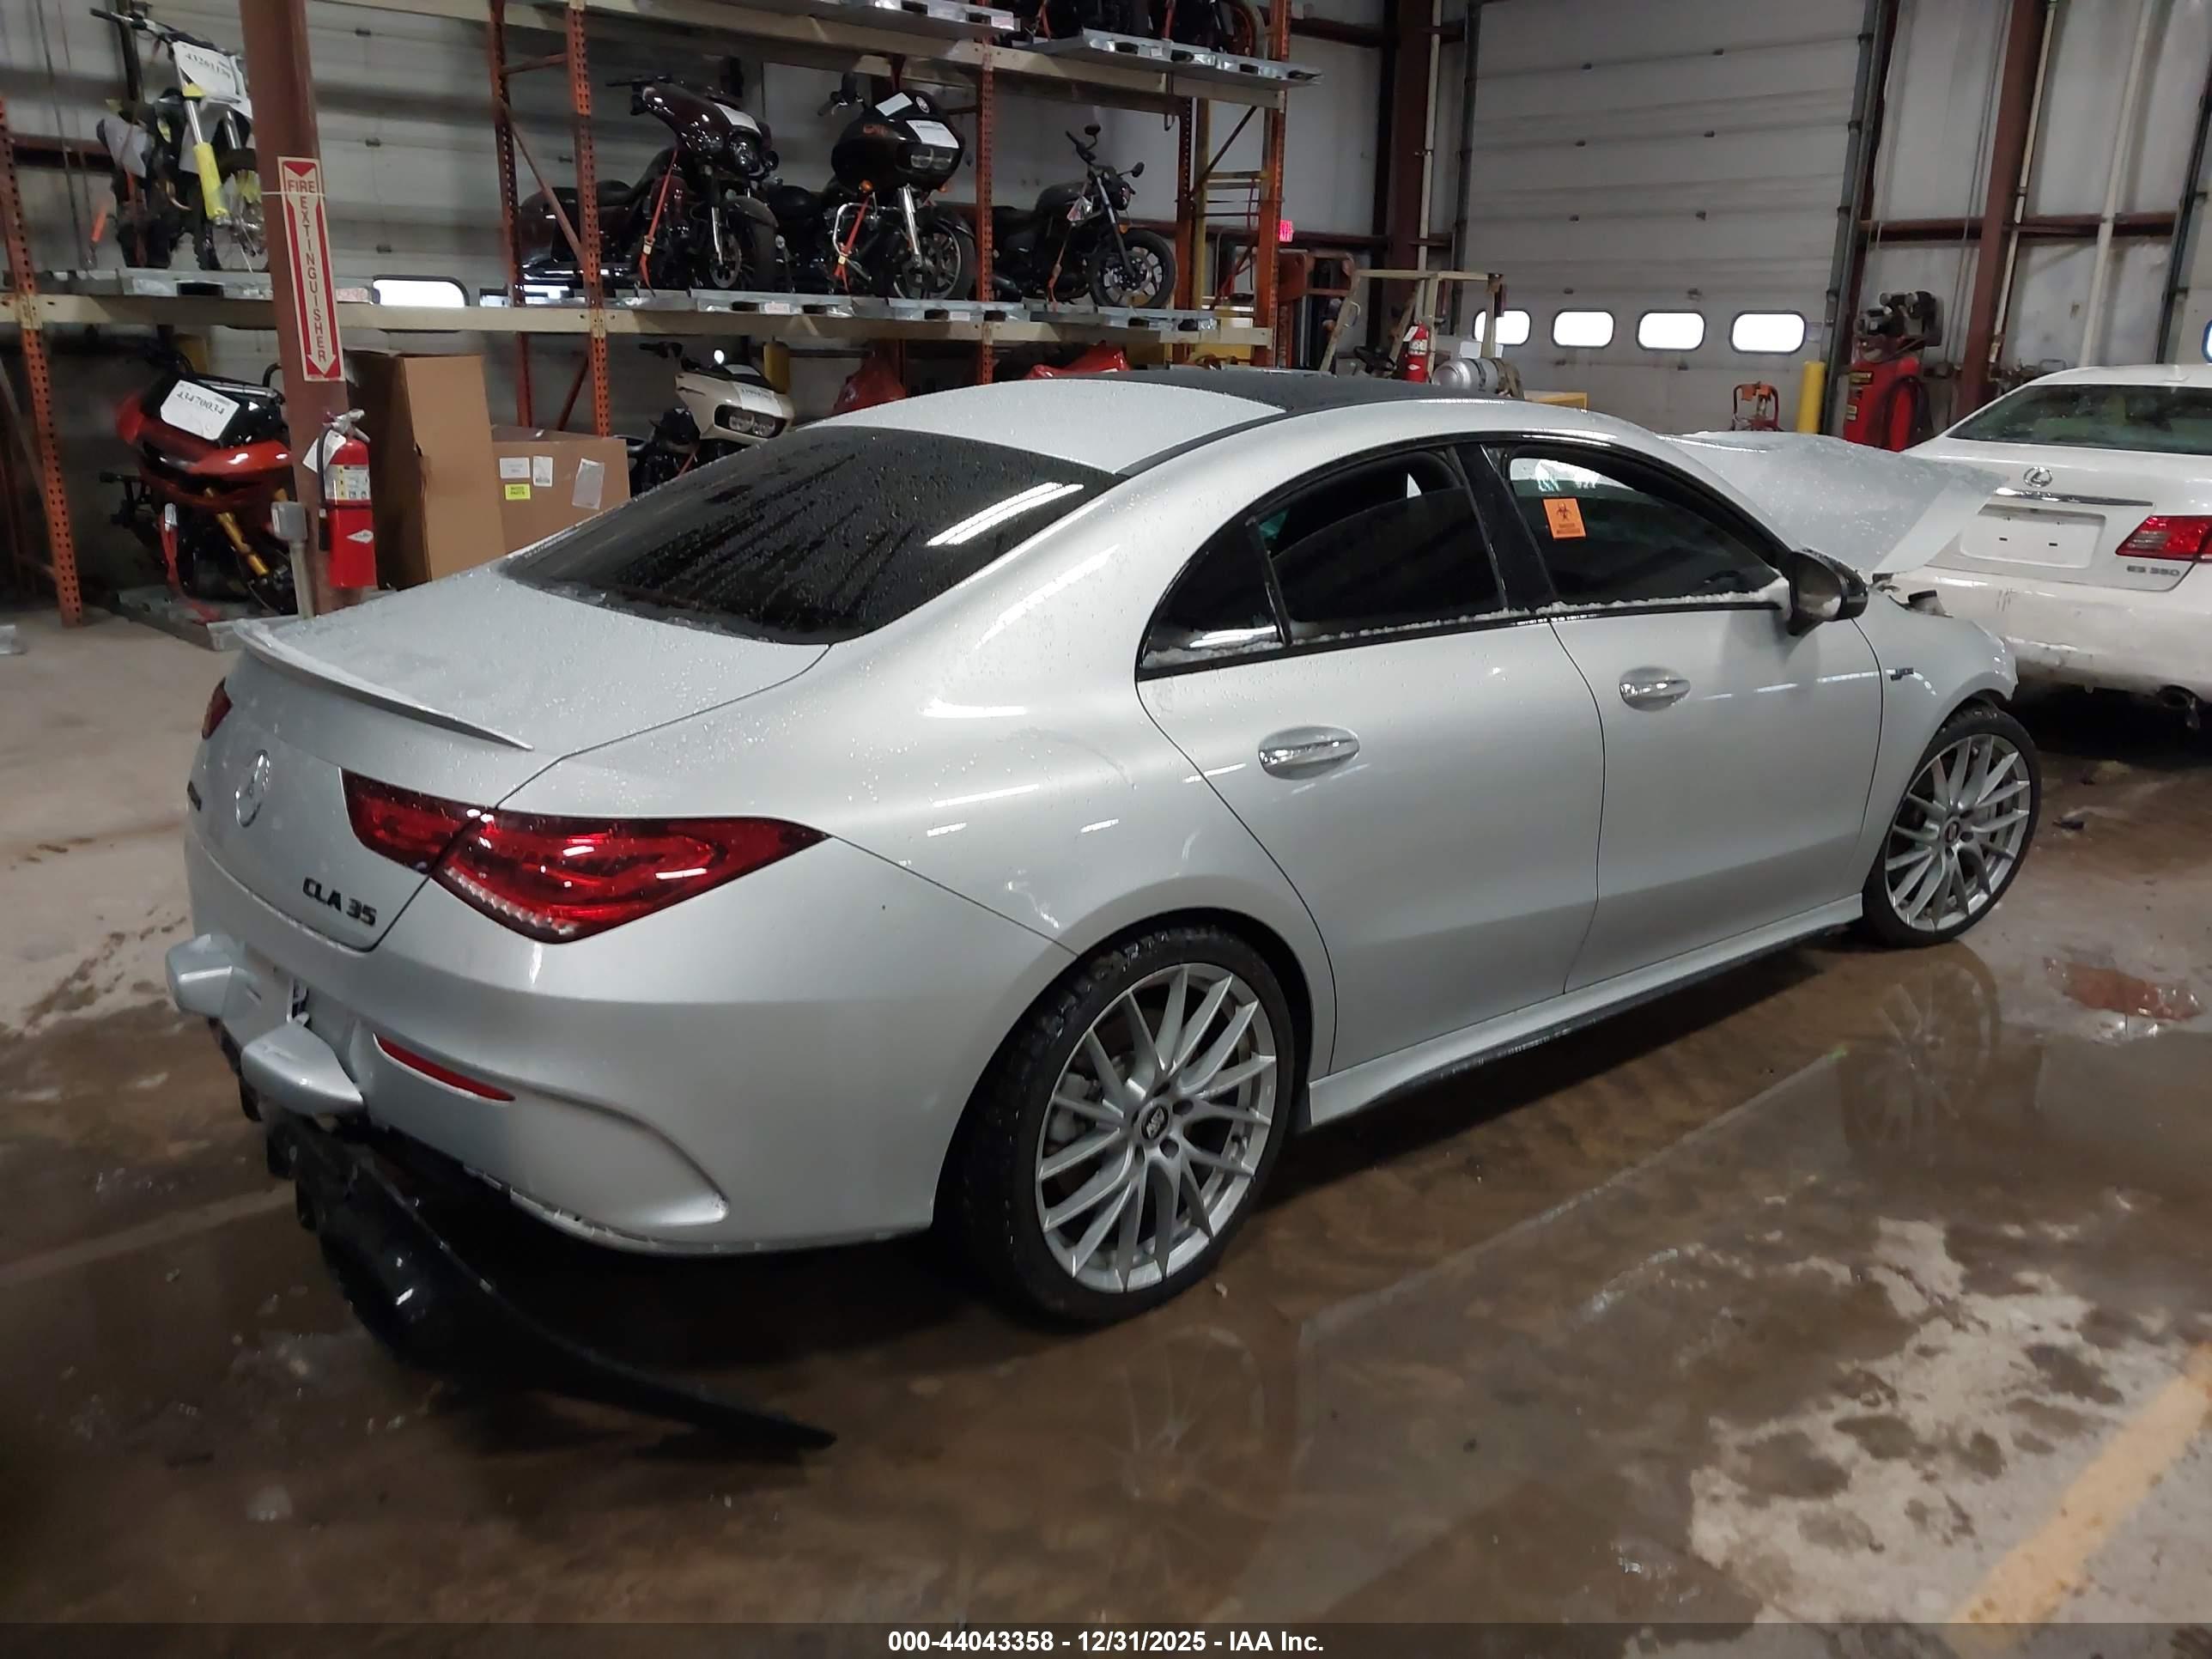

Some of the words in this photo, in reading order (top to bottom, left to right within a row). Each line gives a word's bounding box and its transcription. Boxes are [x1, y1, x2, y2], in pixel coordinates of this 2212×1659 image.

[288, 179, 316, 193] FIRE
[300, 196, 326, 362] EXTINGUISHER
[302, 877, 342, 913] CLA
[346, 898, 377, 927] 35
